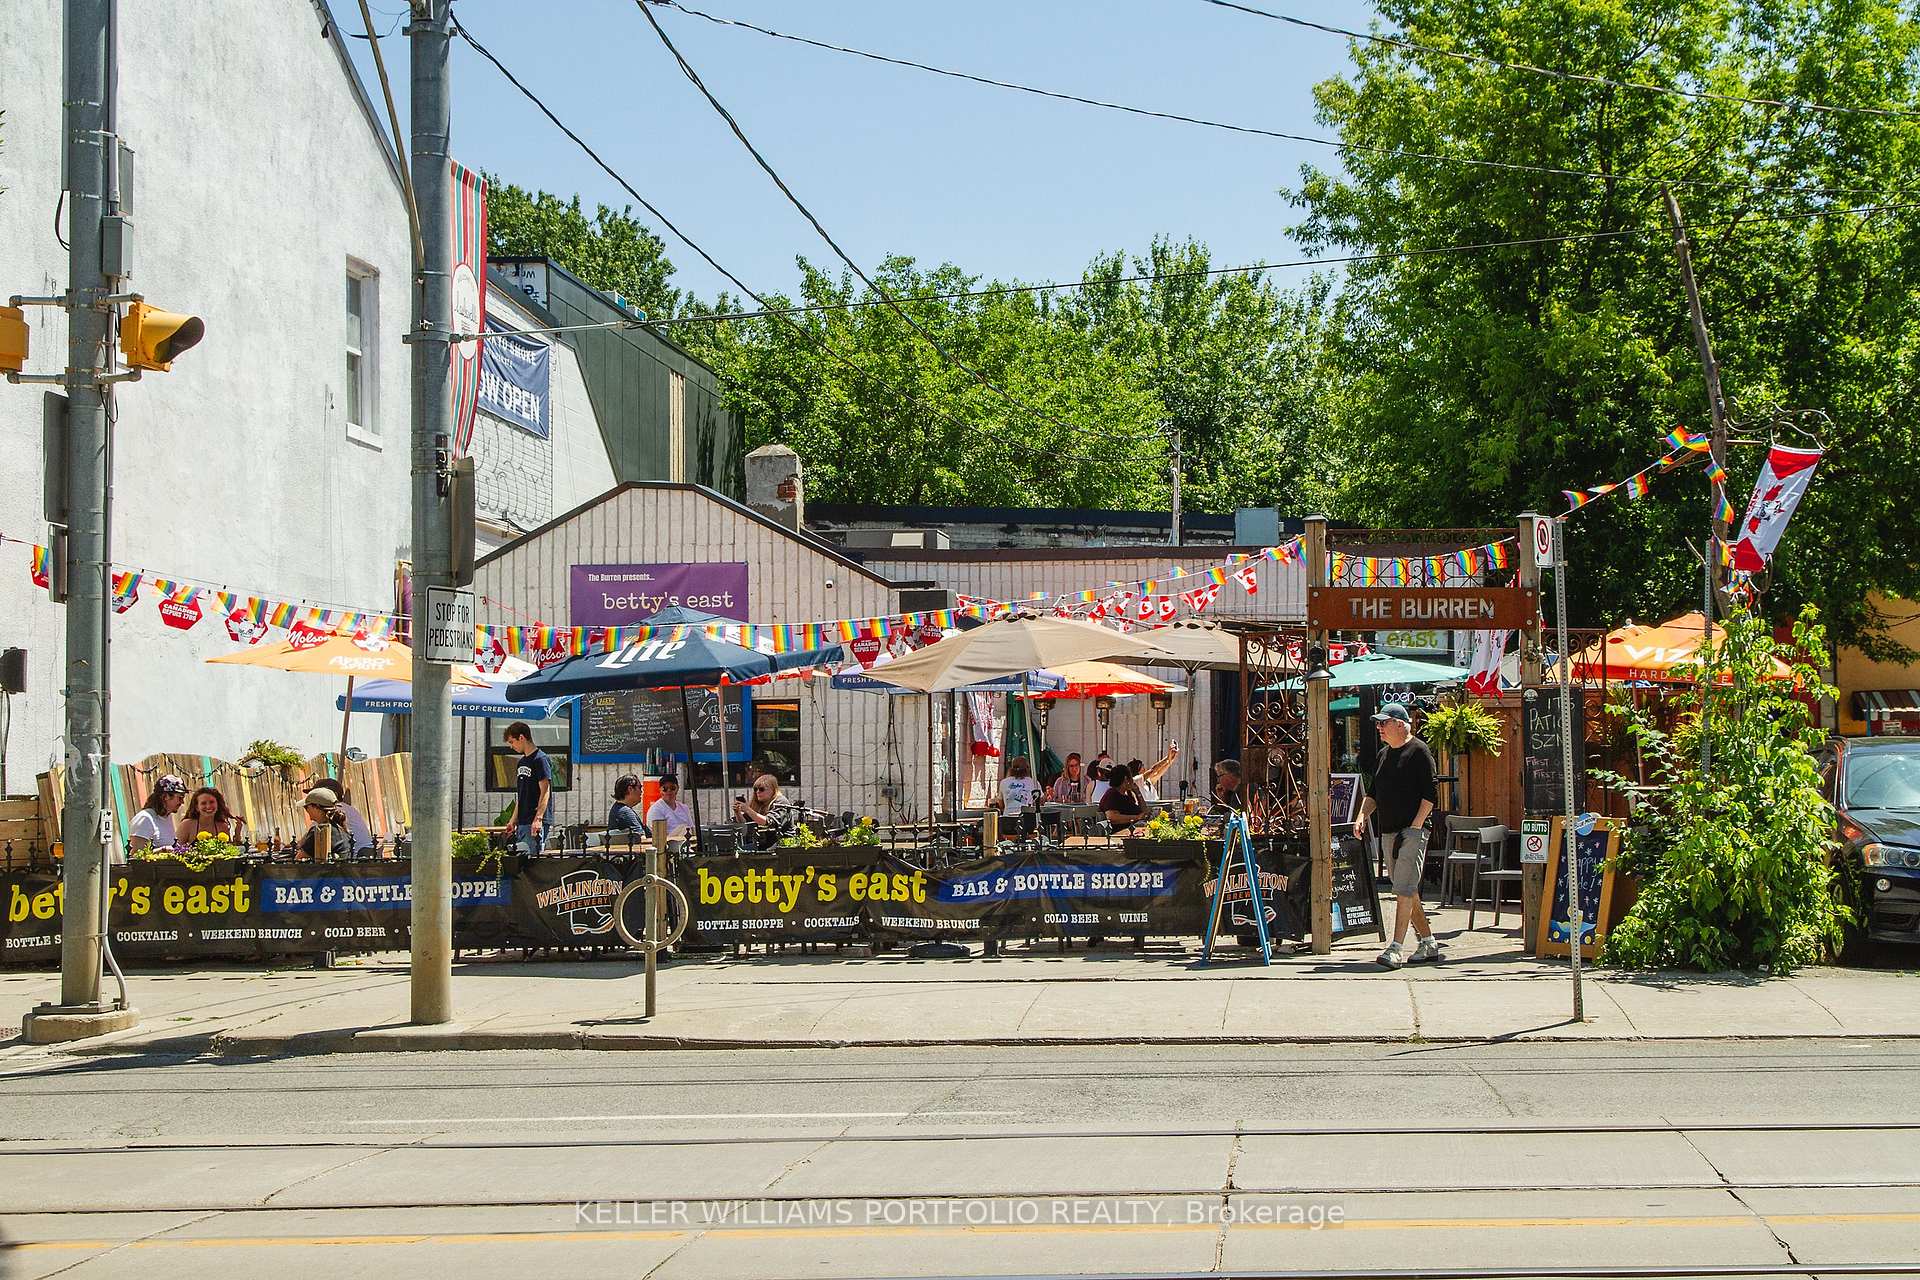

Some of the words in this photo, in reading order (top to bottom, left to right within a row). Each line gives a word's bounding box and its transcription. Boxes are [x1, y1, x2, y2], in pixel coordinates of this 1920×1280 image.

[503, 380, 540, 424] OPEN
[588, 573, 600, 582] The
[601, 573, 622, 582] Burren
[602, 591, 679, 613] betty's
[687, 591, 734, 608] east
[1350, 598, 1392, 619] THE
[1401, 598, 1495, 619] BURREN
[436, 602, 456, 621] STOP
[458, 605, 470, 624] FOR
[286, 631, 331, 648] Molson
[428, 629, 473, 650] PEDESTRIANS
[1387, 630, 1438, 648] east
[329, 656, 395, 666] APEROL
[531, 648, 568, 665] Molson
[595, 636, 687, 669] Lite
[1624, 644, 1705, 665] VIZ
[1629, 669, 1668, 680] HARD
[393, 701, 413, 709] FRO
[1384, 691, 1416, 705] open
[482, 705, 525, 714] CREEMORE
[1523, 822, 1531, 832] NO
[1531, 822, 1548, 833] BUTTS
[275, 887, 314, 904] BAR
[320, 886, 336, 903] &
[342, 883, 412, 903] BOTTLE
[450, 880, 498, 898] OPPE
[697, 866, 838, 912] betty's
[849, 870, 928, 903] east
[952, 880, 990, 897] BAR
[995, 877, 1009, 893] &
[1014, 873, 1085, 891] BOTTLE
[1091, 872, 1164, 889] SHOPPE
[9, 877, 151, 922] bet's
[163, 877, 250, 915] east
[536, 878, 623, 909] WELLINGTON
[1226, 890, 1268, 901] BREWY
[564, 897, 608, 911] BREWERY
[697, 919, 740, 930] BOTTLE
[742, 918, 784, 929] SHOPPE
[804, 915, 860, 928] COCKTAILS
[881, 916, 934, 929] WEEKEND
[936, 918, 980, 929] BRUNCH
[1044, 913, 1068, 924] COLD
[1071, 913, 1100, 924] BEER
[1119, 912, 1148, 923] WINE
[1347, 918, 1358, 926] REAL
[6, 935, 50, 949] BOTTLE
[116, 930, 178, 942] COCKTAILS
[201, 928, 256, 940] WEEKEND
[258, 928, 302, 939] BRUNCH
[325, 927, 354, 938] COLD
[356, 927, 386, 938] BEER
